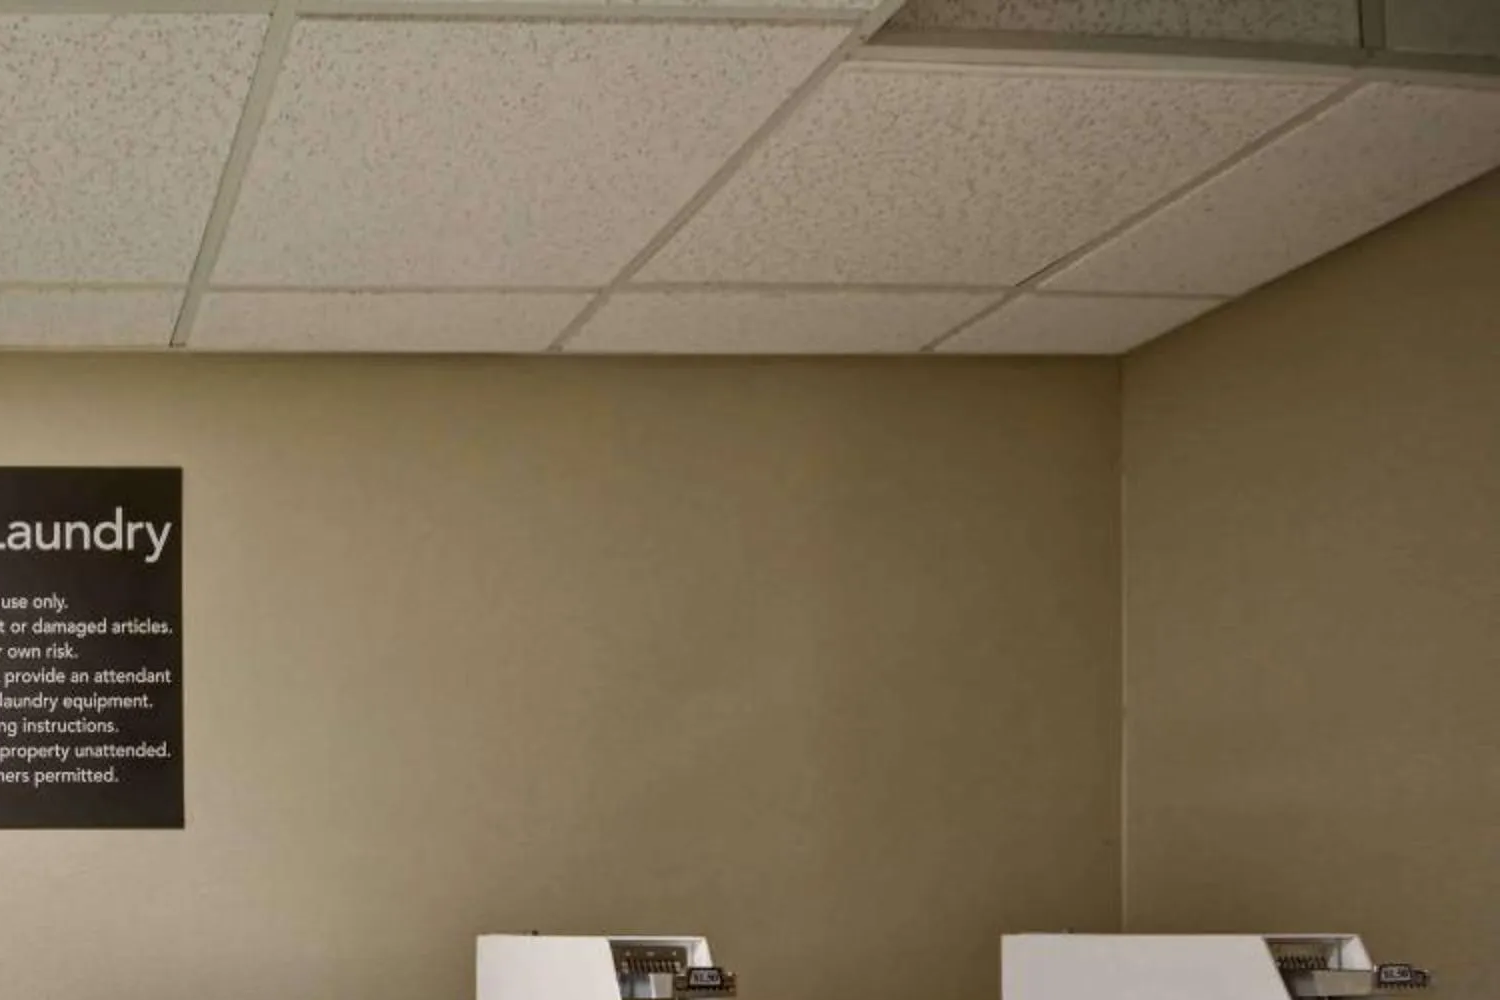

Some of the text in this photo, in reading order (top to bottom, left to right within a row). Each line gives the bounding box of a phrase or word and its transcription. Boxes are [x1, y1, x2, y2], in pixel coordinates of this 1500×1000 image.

[1, 597, 28, 609] use
[32, 592, 68, 613] only.
[10, 622, 28, 634] or
[32, 617, 107, 638] damaged
[111, 617, 172, 634] articles.
[7, 647, 41, 659] own
[46, 642, 78, 659] risk.
[4, 667, 66, 688] provide
[70, 672, 89, 683] an
[93, 667, 172, 684] attendant
[0, 692, 58, 713] laundry
[63, 692, 153, 713] equipment.
[23, 717, 119, 733] instructions.
[0, 744, 70, 763] property
[75, 741, 171, 758] unattended.
[34, 766, 119, 788] permitted.
